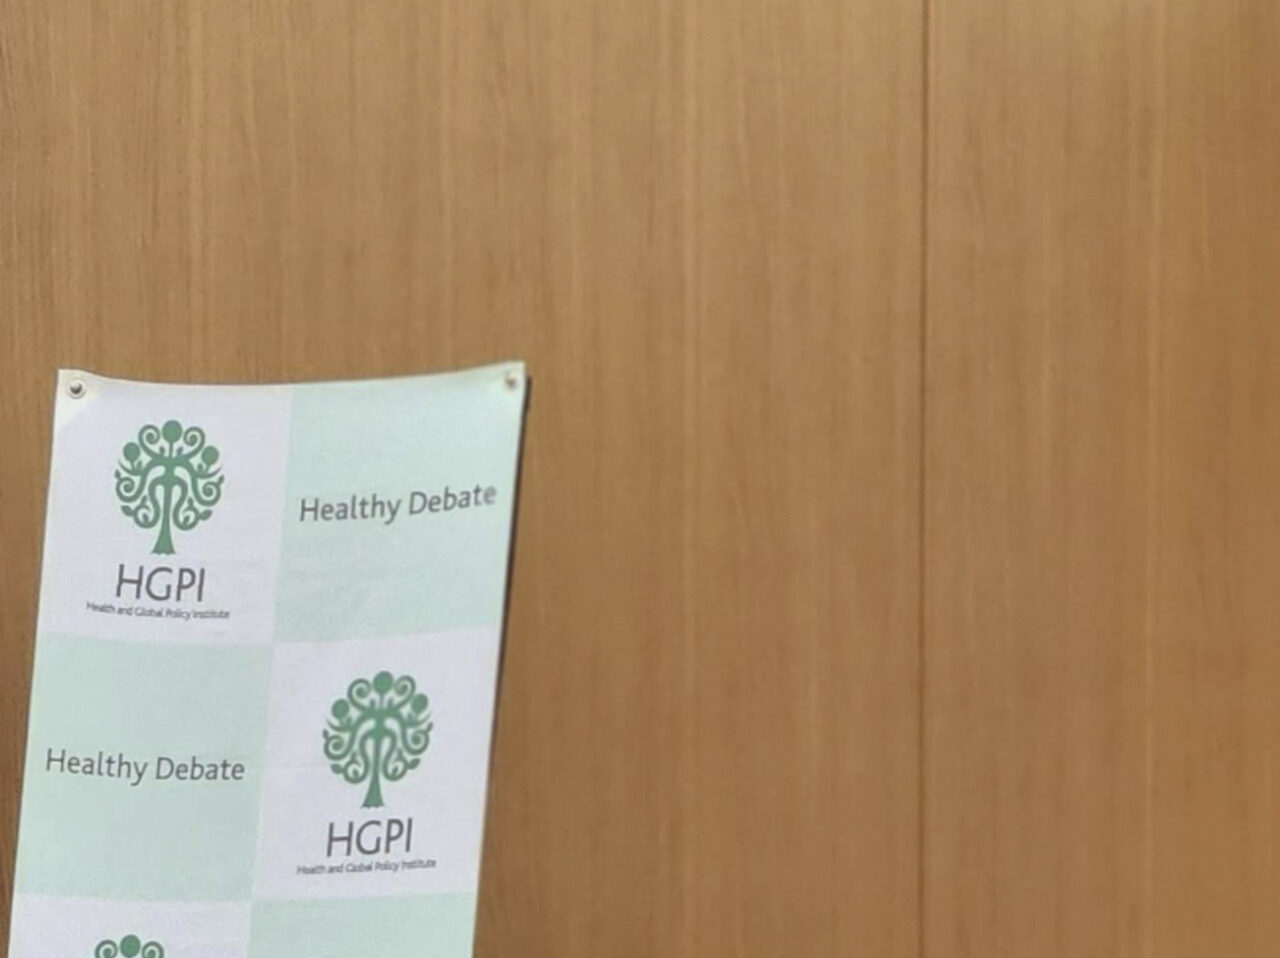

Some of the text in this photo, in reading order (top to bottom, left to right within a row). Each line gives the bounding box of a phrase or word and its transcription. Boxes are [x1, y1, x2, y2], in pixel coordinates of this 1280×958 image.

[300, 484, 498, 525] Healthy Debate
[116, 564, 205, 602] HGPI
[86, 602, 230, 621] Health and Global Policy Institute
[46, 748, 245, 786] Healthy Debate
[327, 817, 413, 857] HGPI
[296, 859, 436, 875] Health and Global Policy Institute
